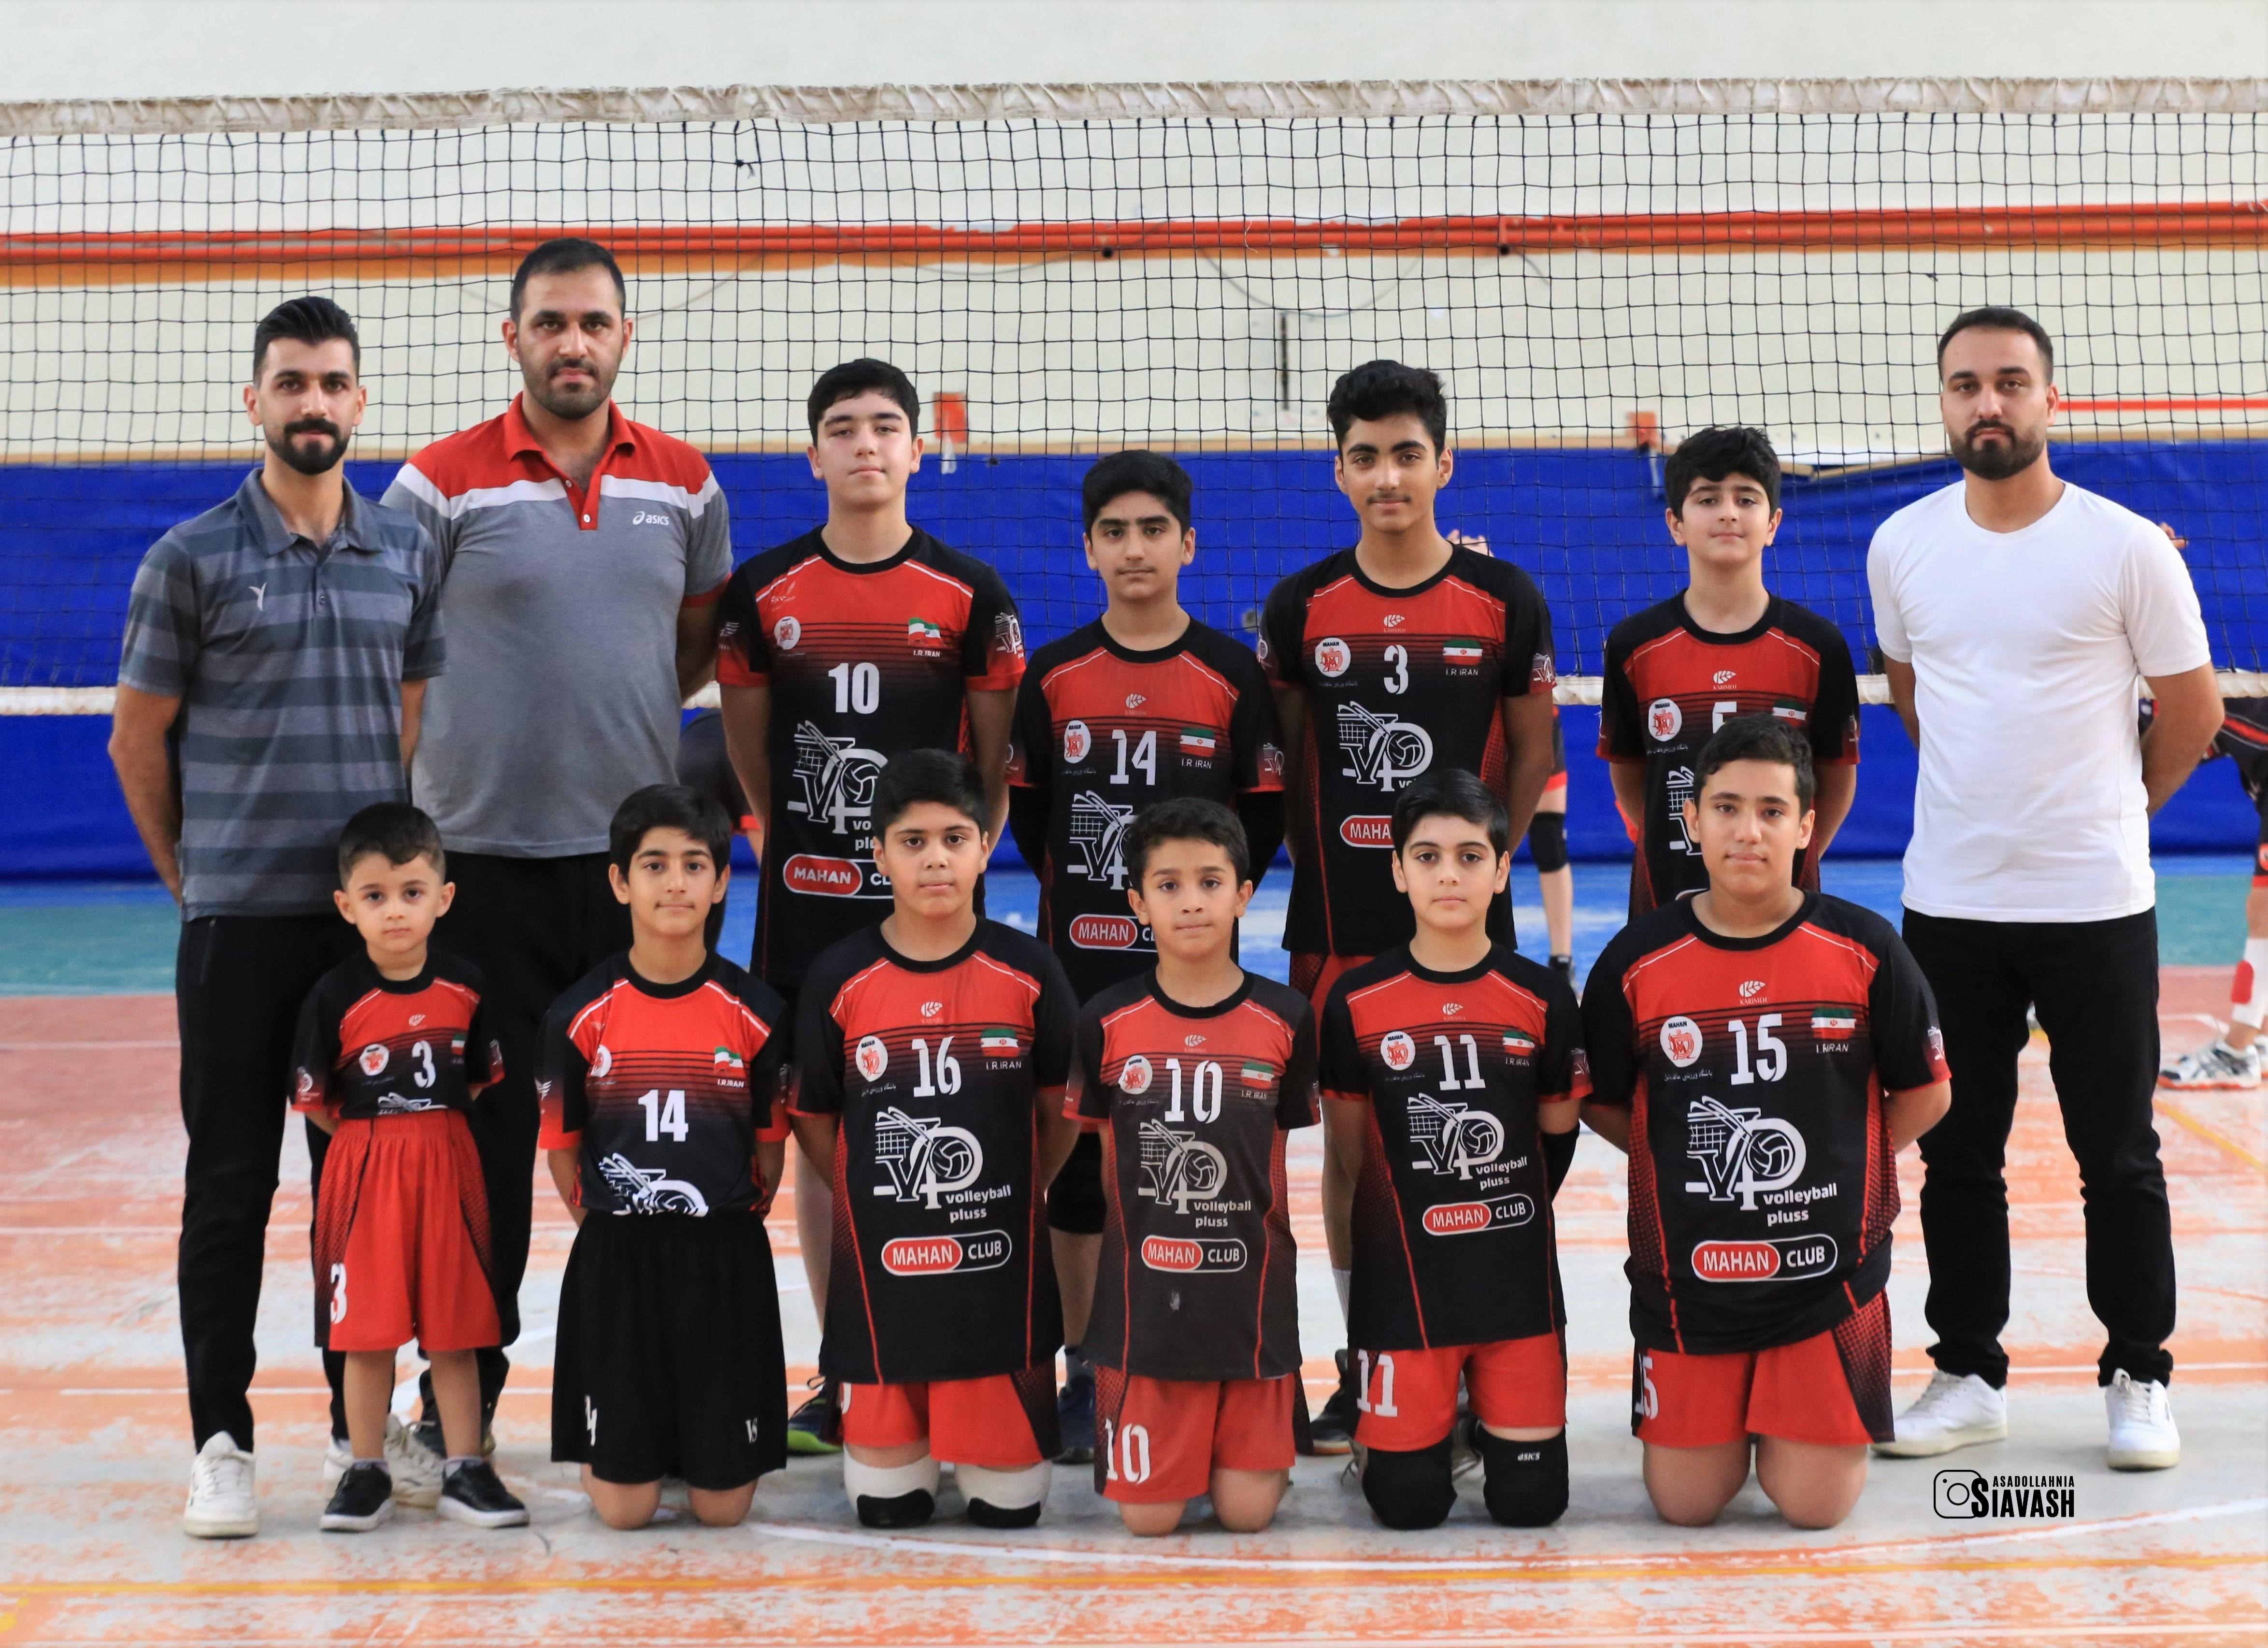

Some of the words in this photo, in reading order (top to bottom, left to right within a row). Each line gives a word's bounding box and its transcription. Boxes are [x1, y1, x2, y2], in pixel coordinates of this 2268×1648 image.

[646, 514, 669, 526] asics
[1383, 644, 1409, 695] 3
[828, 662, 880, 715] 10
[1110, 729, 1157, 786] 14
[1349, 823, 1392, 839] MAHA
[793, 866, 852, 885] MAHAN
[870, 873, 892, 886] CL
[1078, 922, 1129, 942] MAHAN
[1668, 1021, 1688, 1029] MAHAN
[1434, 1034, 1486, 1090] 11
[1728, 1013, 1787, 1085] 15
[412, 1040, 436, 1088] 3
[911, 1035, 962, 1097] 16
[1164, 1058, 1223, 1124] 10
[638, 1089, 689, 1142] 14
[1475, 1156, 1527, 1175] volleyball
[945, 1184, 1011, 1204] volleyball
[1479, 1177, 1510, 1191] pluss
[1763, 1182, 1837, 1205] volleyball
[949, 1208, 987, 1223] pluss
[1193, 1200, 1251, 1214] volleyball
[1432, 1208, 1484, 1228] MAHAN
[1495, 1202, 1526, 1219] CLUB
[1767, 1209, 1809, 1227] pluss
[1195, 1216, 1228, 1229] pluss
[892, 1244, 953, 1266] MAHAN
[968, 1240, 1002, 1260] CLUB
[1148, 1243, 1195, 1264] MAHAN
[1207, 1248, 1240, 1263] CLUB
[1703, 1250, 1770, 1272] MAHAN
[1786, 1246, 1825, 1268] CLUB
[330, 1262, 347, 1325] 3
[1357, 1348, 1398, 1418] 11
[1105, 1418, 1151, 1485] 10
